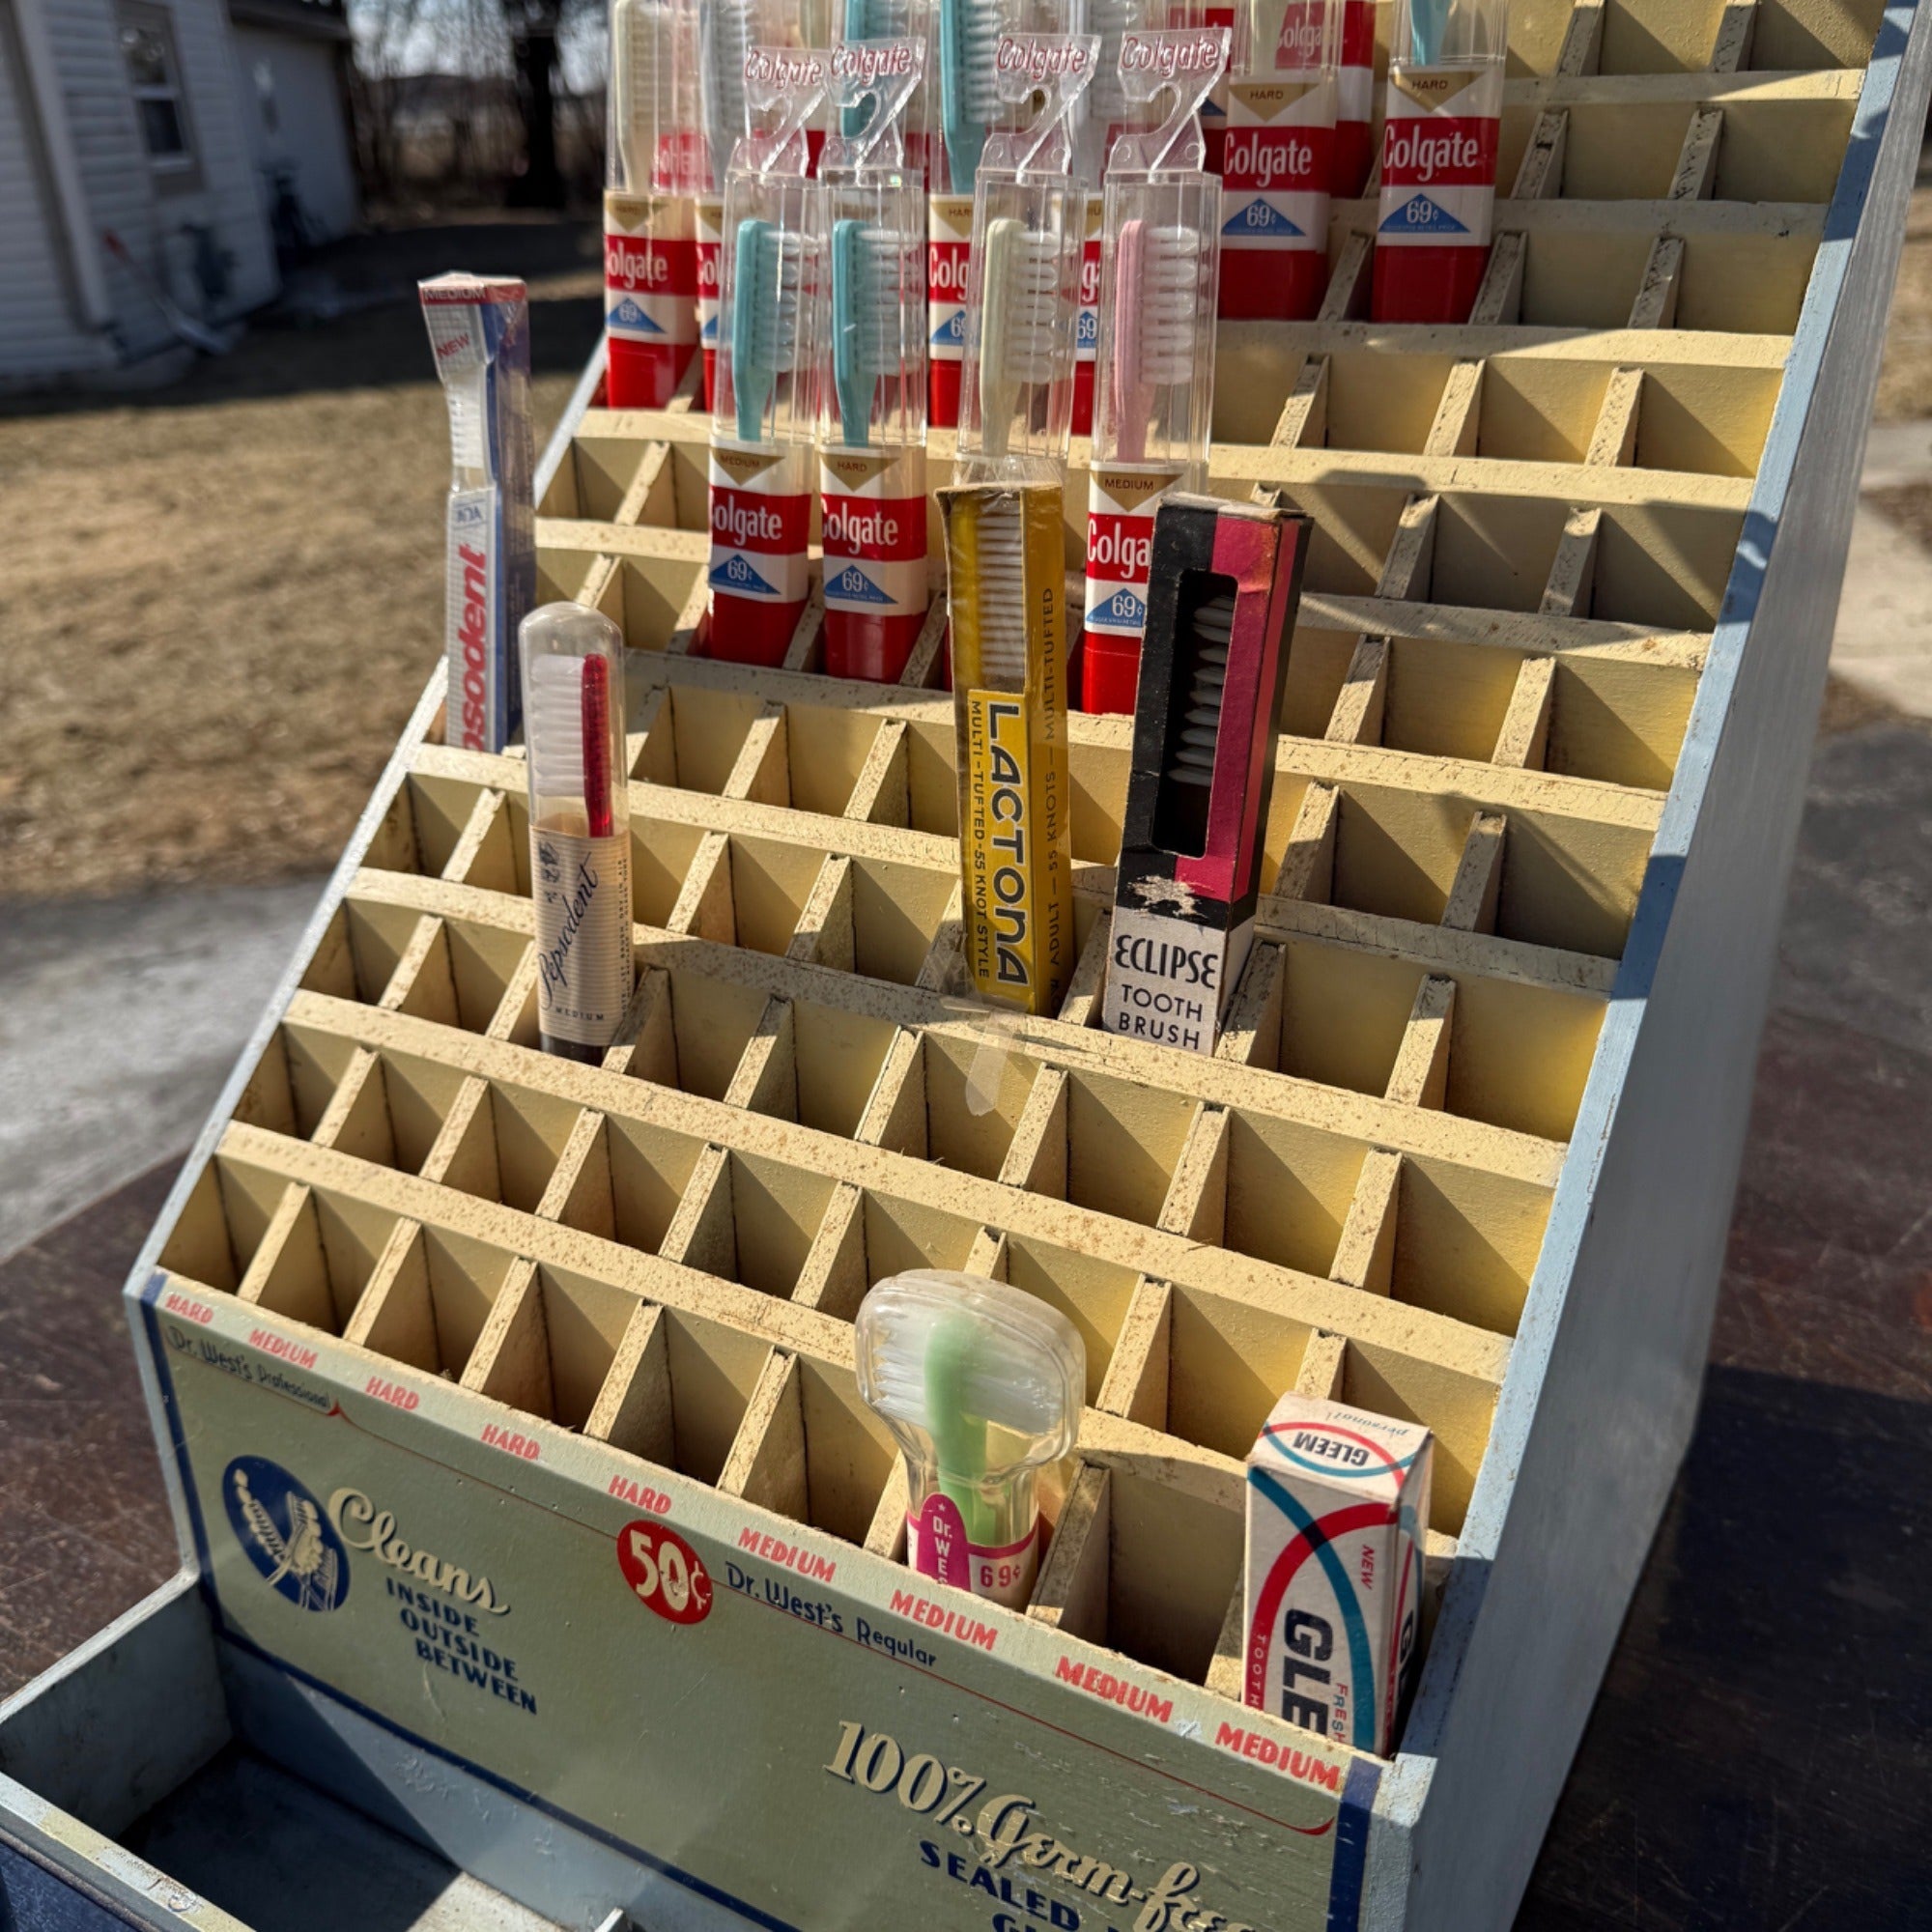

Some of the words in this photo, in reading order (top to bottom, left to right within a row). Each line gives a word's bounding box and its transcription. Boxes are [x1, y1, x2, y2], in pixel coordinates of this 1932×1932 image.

[831, 44, 911, 86] Colgate
[997, 37, 1088, 81] Colgate
[1122, 37, 1218, 78] Colgate
[1250, 89, 1284, 100] HARD
[1411, 79, 1448, 91] HARD
[1224, 131, 1312, 187] Colgate
[1382, 125, 1478, 182] Colgate
[606, 239, 668, 290] olgate
[437, 332, 469, 359] NEW
[837, 461, 867, 472] HARD
[1104, 478, 1154, 491] MEDIUM
[712, 495, 782, 547] olgate
[1088, 519, 1151, 580] Colga
[1112, 594, 1143, 618] 69¢
[1043, 587, 1056, 741] MULTI-TUFTED
[1045, 772, 1058, 841] KNOTS
[974, 874, 988, 920] KNOT
[538, 851, 600, 1011] Pepsodent
[976, 925, 990, 979] STYLE
[1048, 902, 1060, 966] ADULT
[1115, 934, 1219, 989] ECLIPSE
[1122, 983, 1203, 1022] TOOTH
[1118, 1011, 1200, 1049] BRUSH
[166, 1293, 214, 1325] HARD
[200, 1339, 253, 1381] West's
[248, 1327, 319, 1369] MEDIUM
[365, 1375, 420, 1410] HARD
[481, 1423, 541, 1461] HARD
[1293, 1432, 1370, 1467] GLEEM
[608, 1474, 672, 1515] HARD
[327, 1487, 512, 1615] Cleans
[932, 1515, 953, 1539] Dr.
[629, 1529, 712, 1612] 50¢
[737, 1526, 838, 1583] MEDIUM
[980, 1565, 1021, 1588] 69¢
[1360, 1545, 1375, 1590] NEW
[386, 1577, 480, 1637] INSIDE
[725, 1561, 759, 1600] Dr.
[766, 1577, 844, 1634] West's
[857, 1616, 937, 1667] Regular
[890, 1588, 999, 1652] MEDIUM
[401, 1607, 519, 1682] OUTSIDE
[415, 1638, 537, 1715] BETWEEN
[1055, 1656, 1174, 1723] MEDIUM
[1282, 1607, 1334, 1736] GLE
[822, 1720, 986, 1835] 100%
[1215, 1721, 1341, 1792] MEDIUM
[919, 1839, 1081, 1932] SEALED
